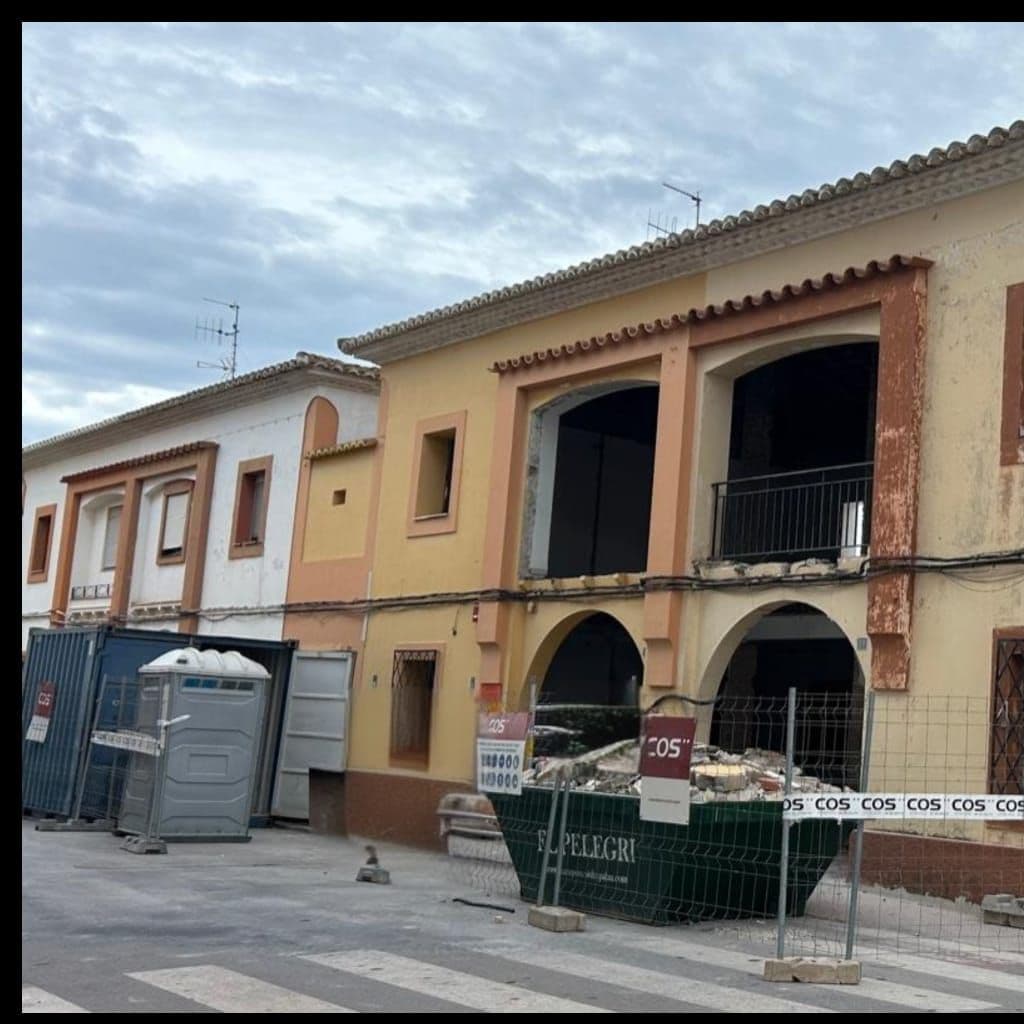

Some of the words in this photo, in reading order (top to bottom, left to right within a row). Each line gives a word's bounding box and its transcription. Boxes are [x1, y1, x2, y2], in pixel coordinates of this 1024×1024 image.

[782, 797, 804, 811] OS
[815, 797, 850, 811] COS
[861, 797, 896, 811] COS
[906, 797, 941, 811] COS
[951, 798, 986, 812] COS
[562, 831, 636, 863] PELEGRI
